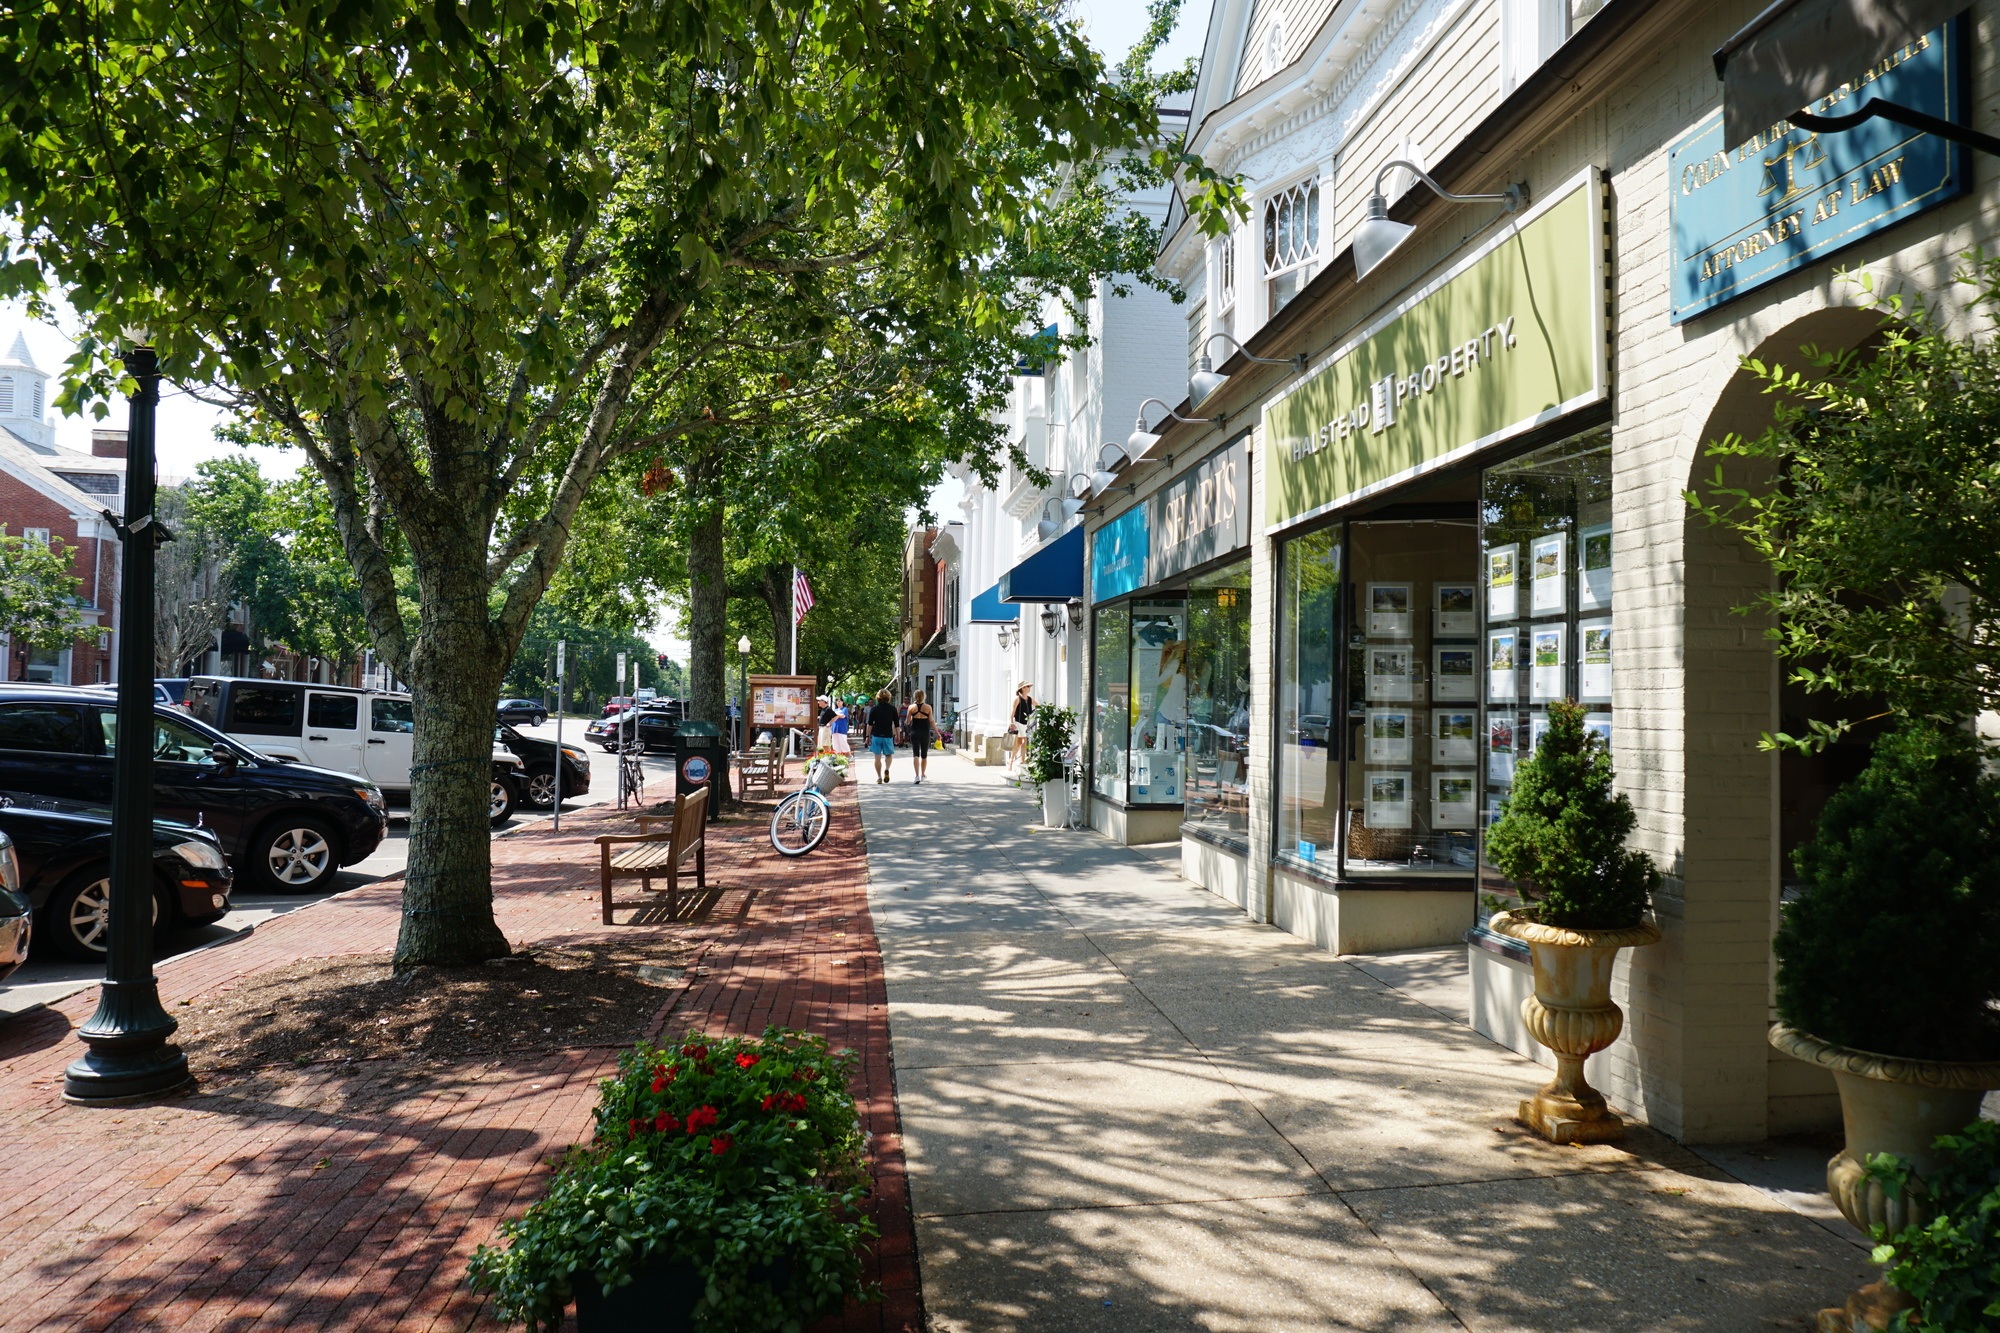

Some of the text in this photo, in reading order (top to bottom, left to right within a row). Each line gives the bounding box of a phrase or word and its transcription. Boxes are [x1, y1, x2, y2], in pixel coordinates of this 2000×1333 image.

[1681, 150, 1731, 197] COLIN
[1700, 156, 1906, 282] ATTORNEY AT LAW
[1291, 401, 1371, 463] HALSTEAD
[1164, 459, 1237, 551] SHARI'S
